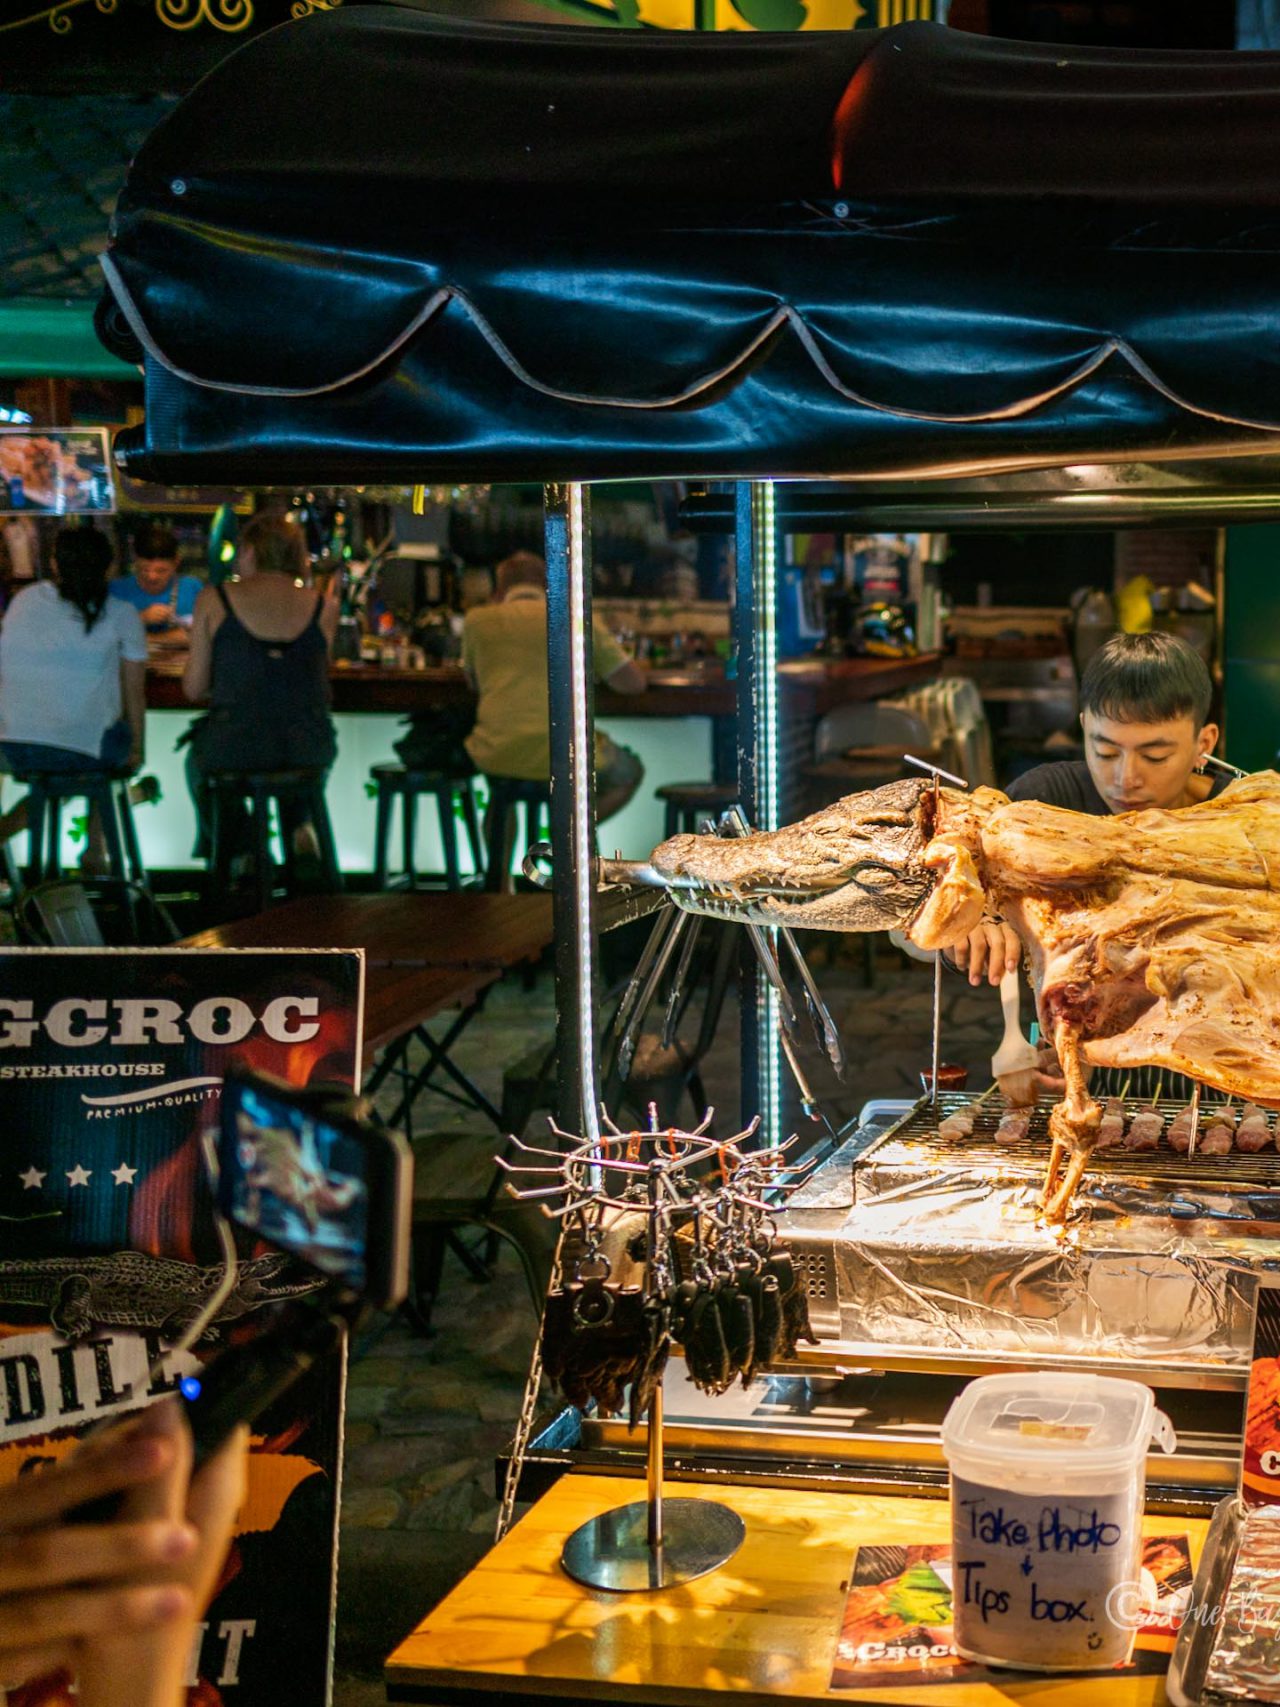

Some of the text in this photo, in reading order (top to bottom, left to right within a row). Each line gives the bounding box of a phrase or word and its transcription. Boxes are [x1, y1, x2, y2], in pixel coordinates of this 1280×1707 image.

[0, 1063, 166, 1079] STEAKHOUSE
[960, 1498, 1122, 1554] Take Photo
[958, 1561, 1011, 1623] Tips
